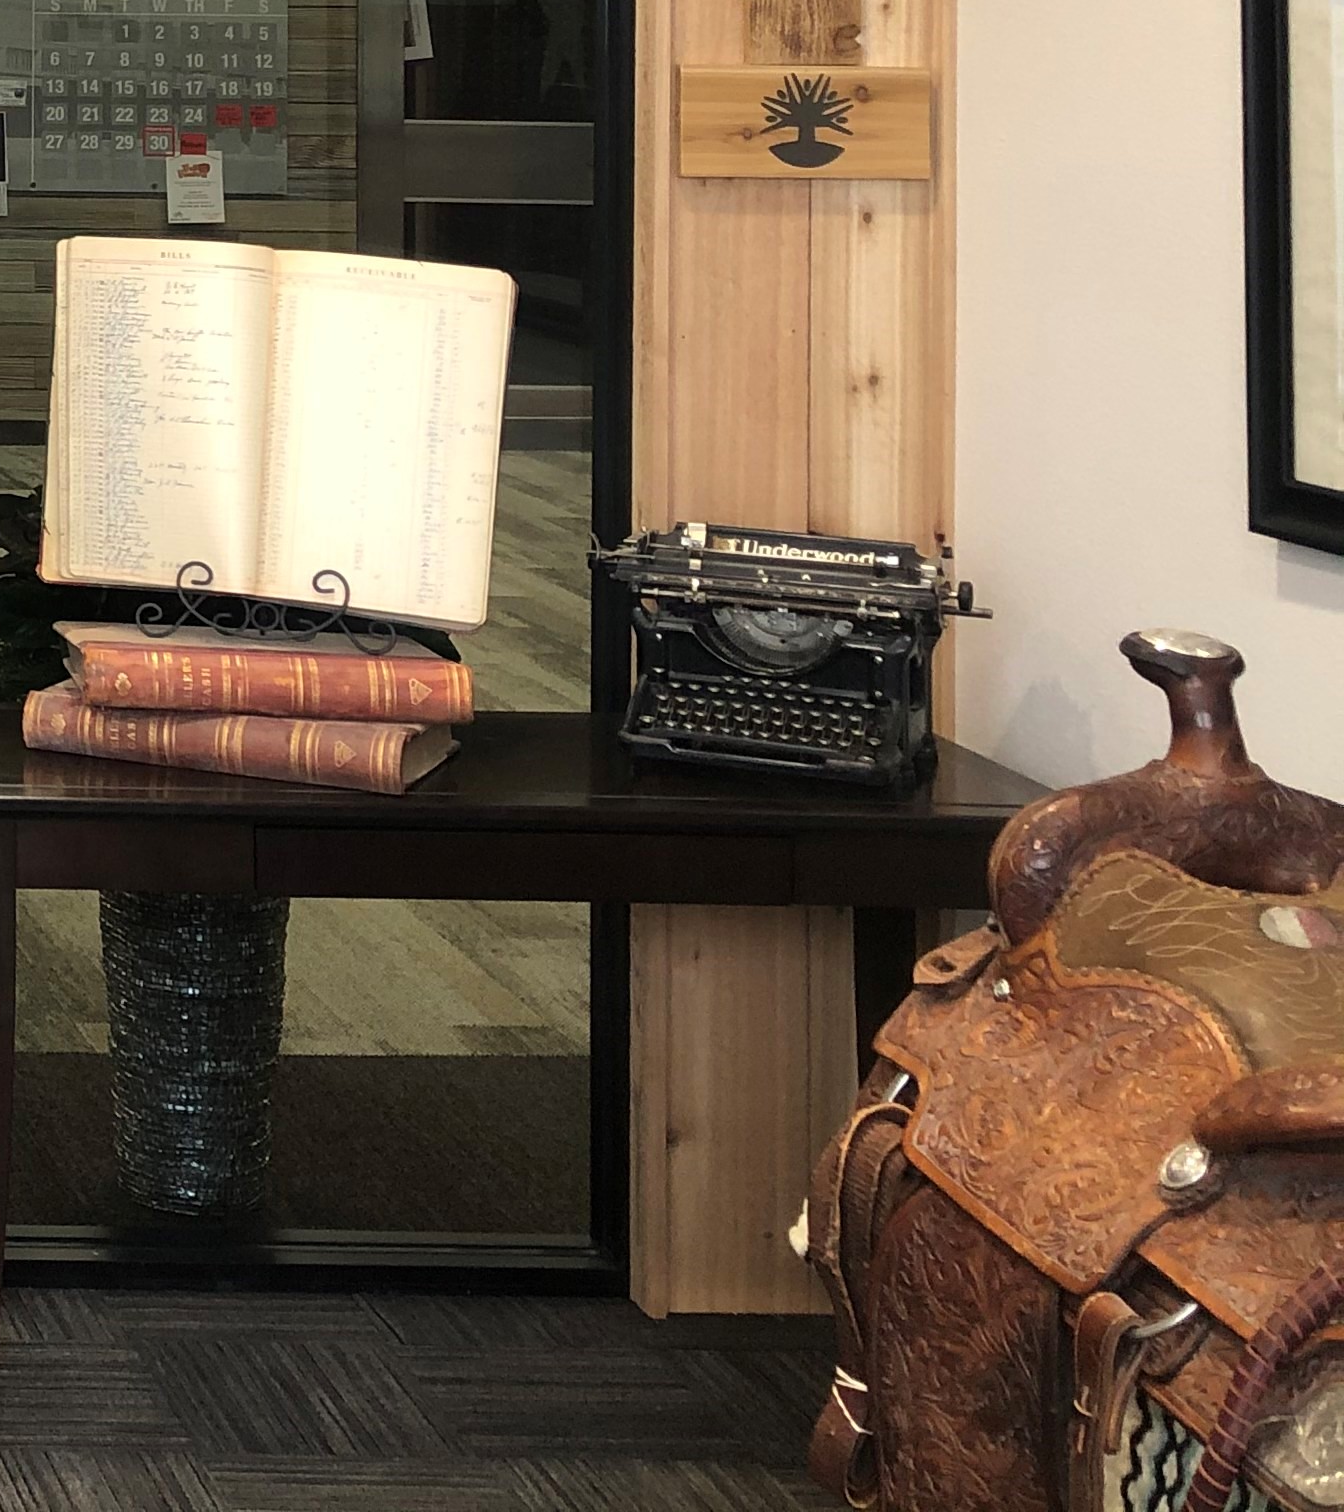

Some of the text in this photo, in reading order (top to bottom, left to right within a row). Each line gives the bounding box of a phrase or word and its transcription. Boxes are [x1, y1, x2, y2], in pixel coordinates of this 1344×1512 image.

[186, 0, 204, 12] TH
[224, 0, 233, 13] F
[259, 0, 269, 13] S
[122, 24, 269, 40] 1 2 3 4 5
[50, 52, 273, 68] 6 7 8 9 10 11 12
[46, 79, 273, 97] 13 14 15 16 17 18 19
[46, 107, 64, 121] 20
[82, 107, 99, 122] 21
[115, 108, 134, 122] 22
[150, 108, 168, 123] 23
[185, 108, 204, 123] 24
[45, 135, 63, 149] 27
[80, 135, 99, 149] 28
[115, 135, 134, 150] 29
[150, 136, 168, 150] 30
[160, 251, 192, 260] BILLS
